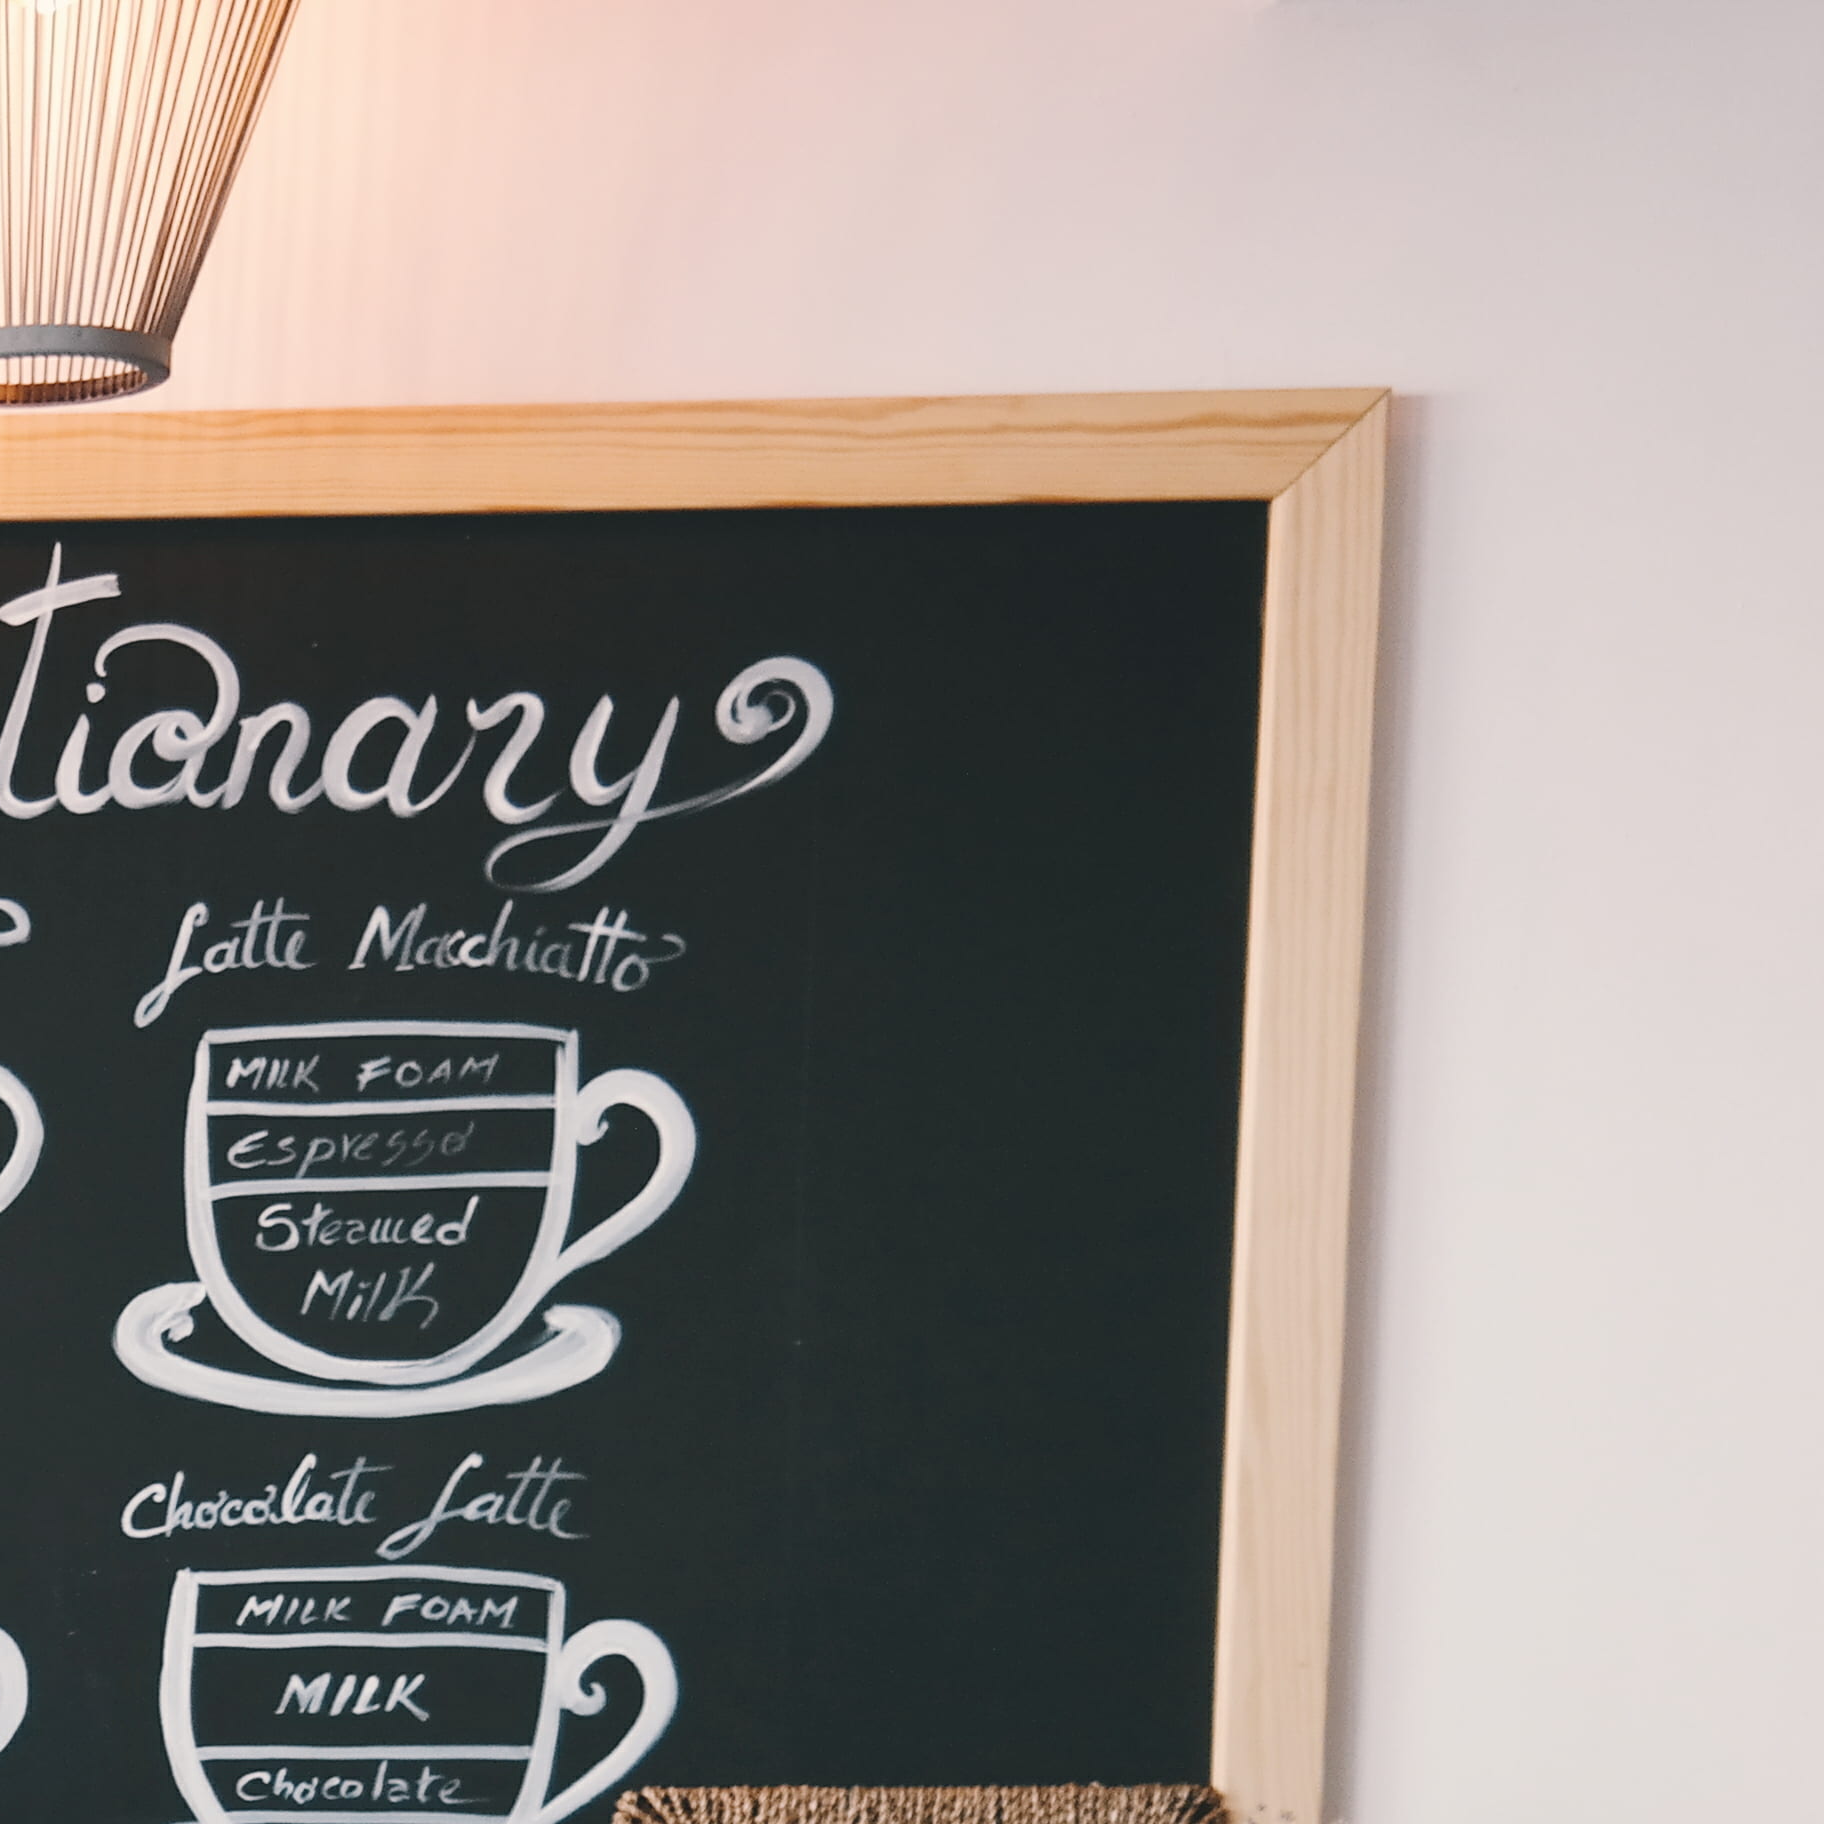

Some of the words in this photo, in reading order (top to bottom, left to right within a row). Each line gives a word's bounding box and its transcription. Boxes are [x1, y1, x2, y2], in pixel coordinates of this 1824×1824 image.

[133, 899, 316, 1029] Latte
[225, 1055, 320, 1094] MILK
[357, 1054, 500, 1092] FOAM
[227, 1121, 474, 1180] Espresso
[255, 1196, 479, 1252] Steamed
[120, 1453, 393, 1539] Chocolate
[375, 1452, 590, 1561] Latte
[236, 1594, 352, 1627] MILK
[381, 1592, 519, 1629] FOAM
[275, 1672, 431, 1721] MILK
[235, 1759, 490, 1805] Chocolate
